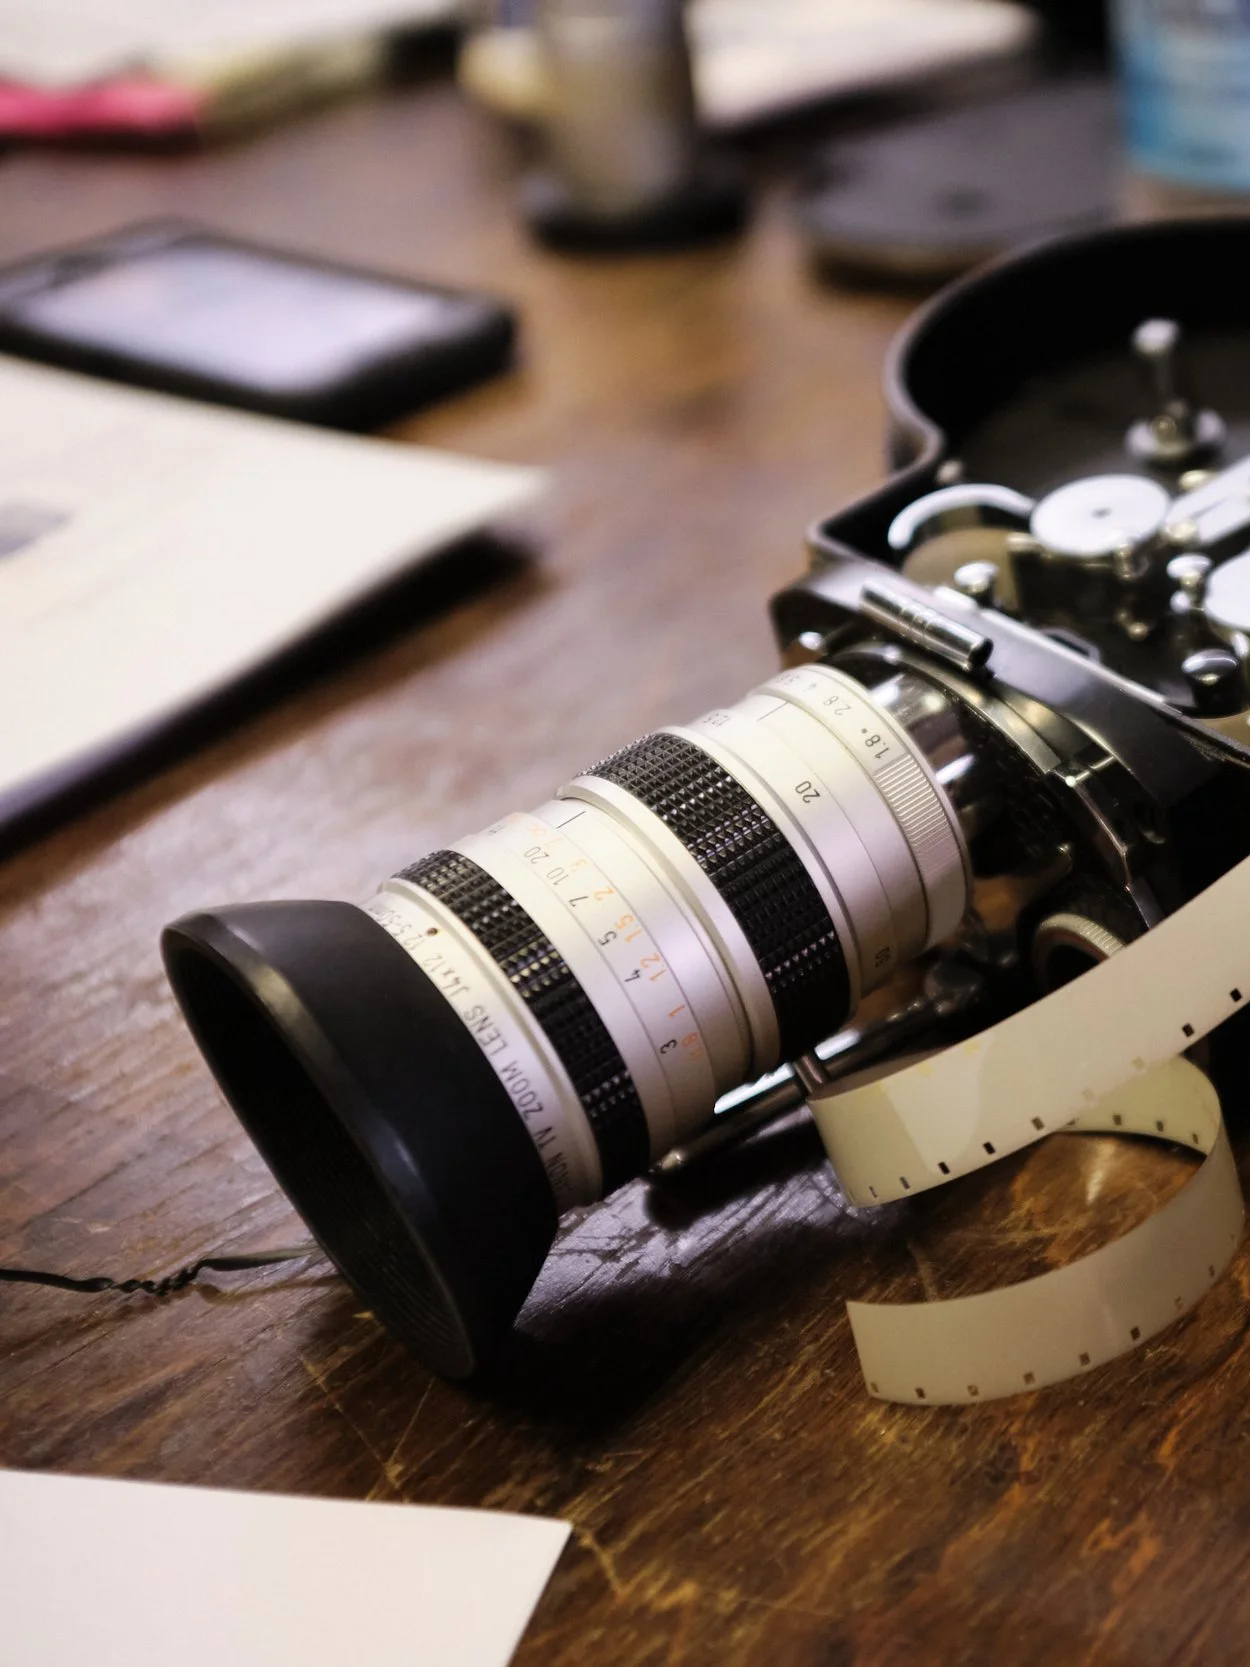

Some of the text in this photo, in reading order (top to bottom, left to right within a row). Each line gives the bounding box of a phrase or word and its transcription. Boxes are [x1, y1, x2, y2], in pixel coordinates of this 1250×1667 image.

[865, 734, 890, 760] 1.8
[795, 780, 821, 804] 20
[594, 887, 615, 902] 2
[523, 846, 677, 1055] 3 4 5 7 10 20
[668, 1004, 686, 1019] 1
[464, 1004, 508, 1057] LENS
[501, 1060, 543, 1120] ZOOM
[533, 1126, 557, 1150] TV
